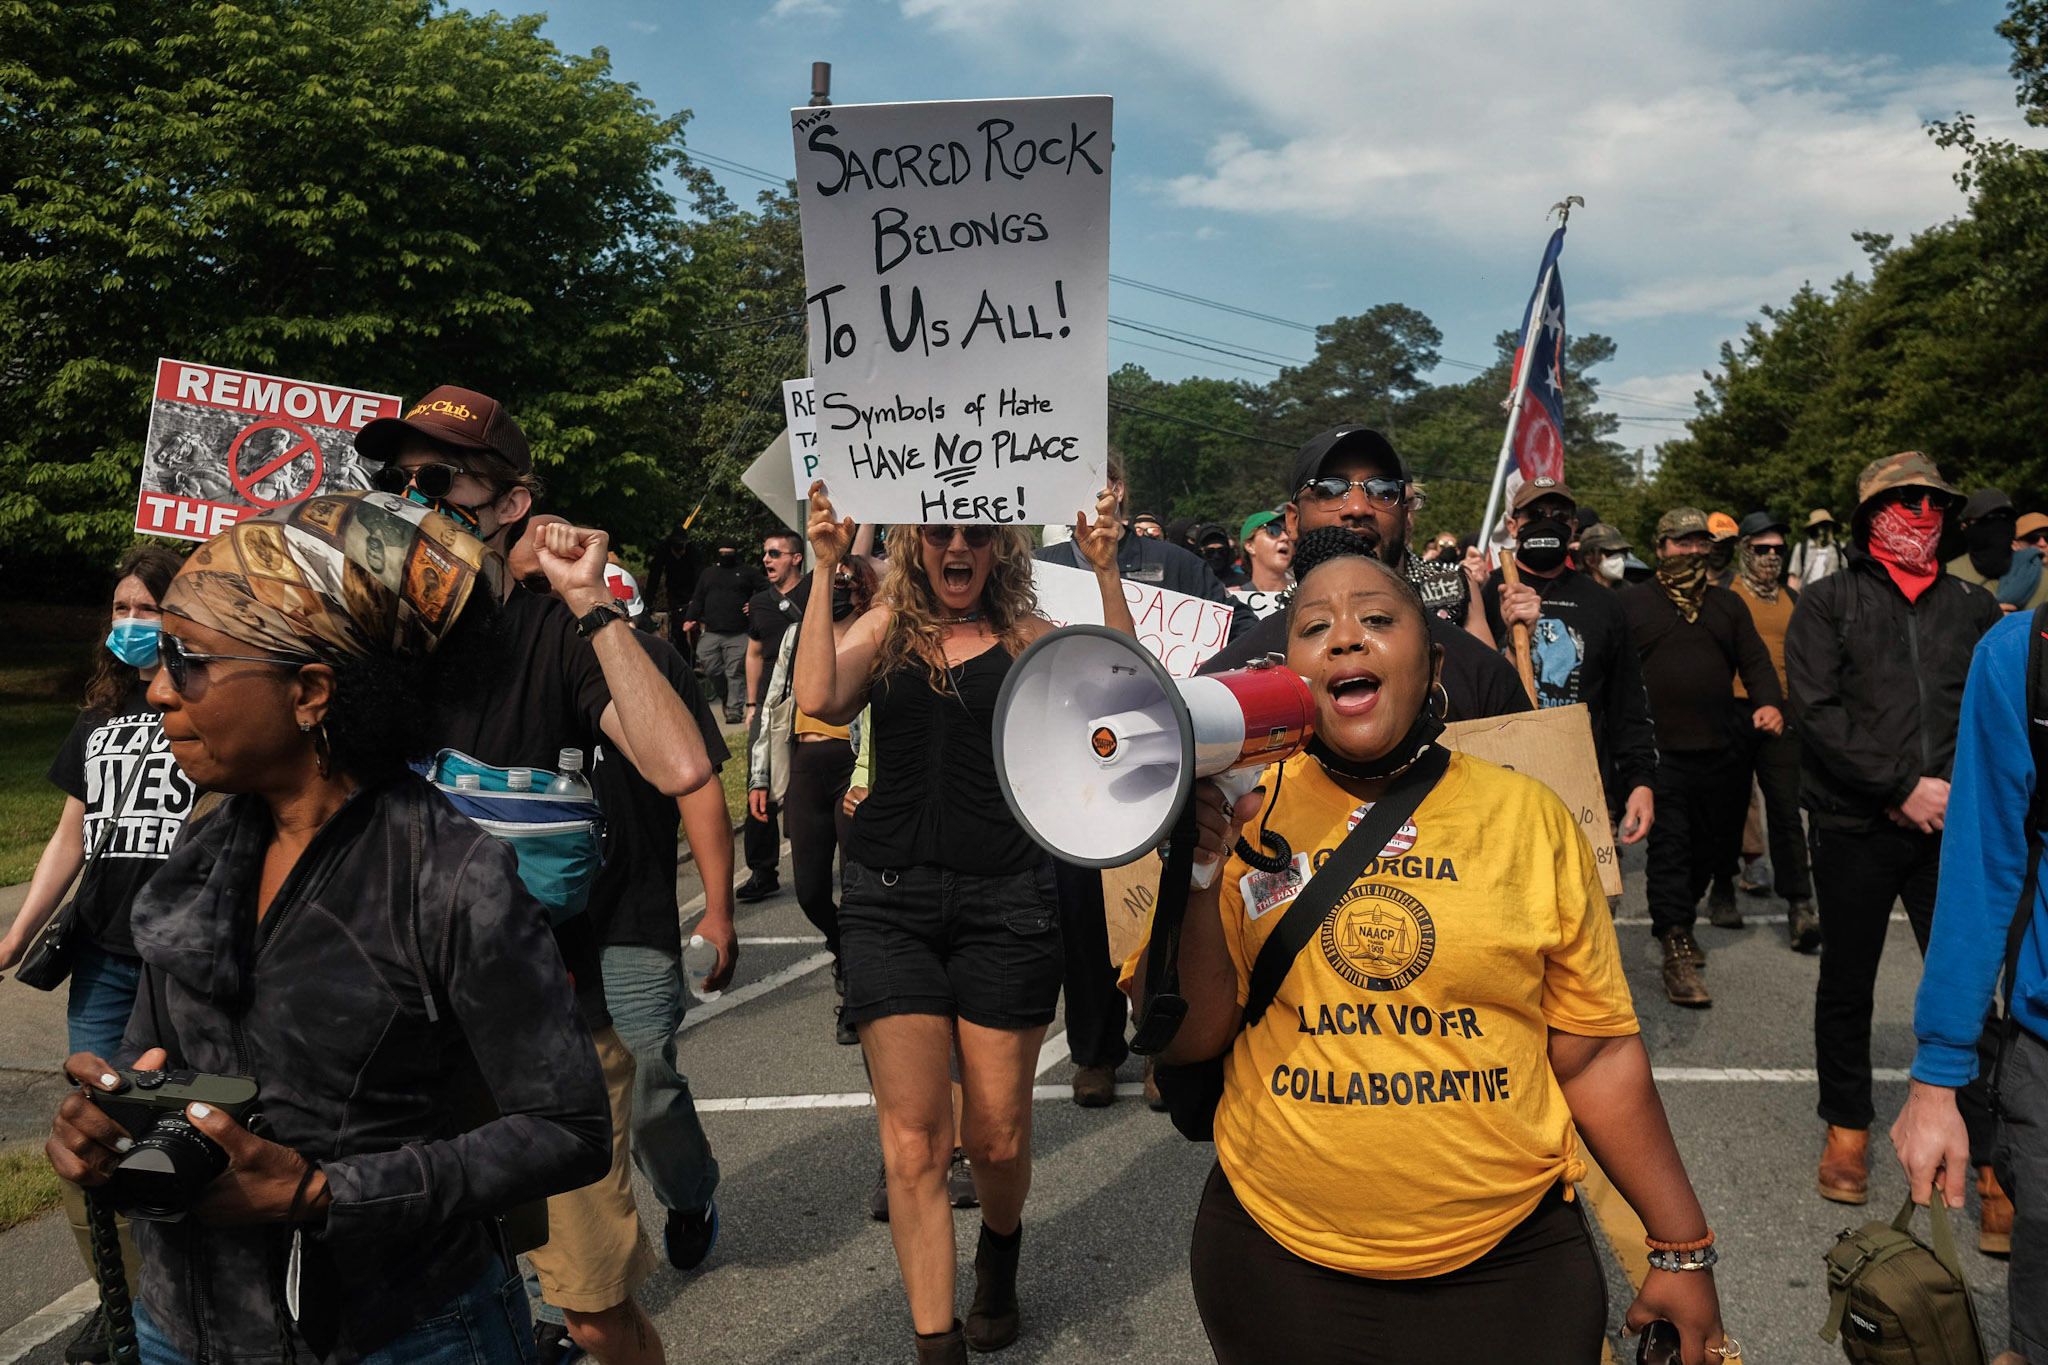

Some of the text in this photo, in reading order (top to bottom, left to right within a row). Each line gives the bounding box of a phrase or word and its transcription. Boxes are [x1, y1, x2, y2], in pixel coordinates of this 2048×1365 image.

[793, 109, 831, 133] This
[808, 125, 970, 196] SACRED
[873, 207, 1049, 275] BELONGS
[961, 280, 1071, 350] ALL!
[176, 366, 381, 429] REMOVE
[432, 400, 471, 418] Club
[823, 387, 1053, 440] Symbols of Hate
[849, 430, 1079, 480] HAVE NO PLACE
[146, 496, 239, 536] THE
[920, 485, 1026, 523] HERE!
[86, 726, 171, 761] BLAC
[1313, 847, 1459, 883] GORGIA
[1257, 883, 1304, 911] THE HATE
[1356, 885, 1372, 896] THE
[1373, 885, 1430, 924] ADVANCEMENT
[1359, 926, 1395, 941] NAACP
[1367, 944, 1384, 955] 1909
[1297, 1002, 1382, 1036] LACK
[1271, 1063, 1510, 1106] COLLABORATIVE
